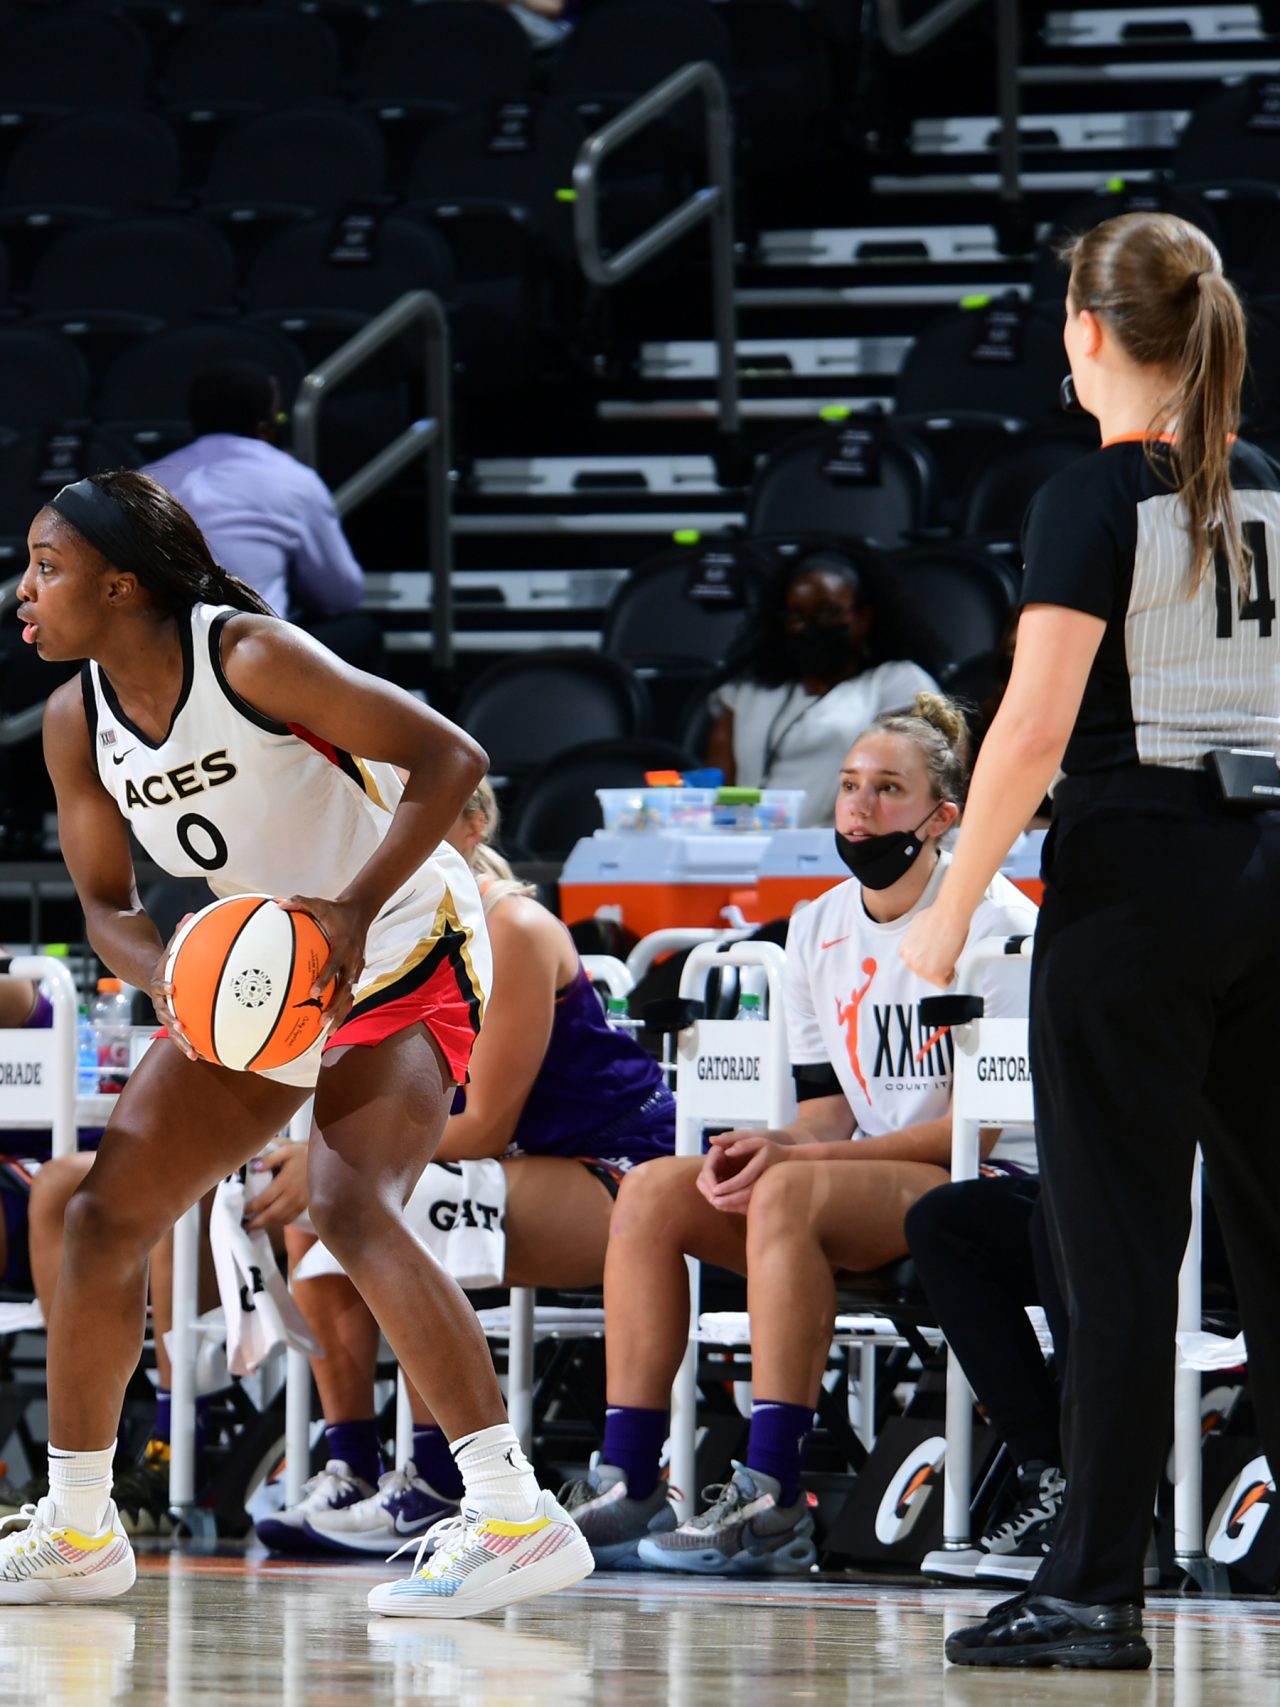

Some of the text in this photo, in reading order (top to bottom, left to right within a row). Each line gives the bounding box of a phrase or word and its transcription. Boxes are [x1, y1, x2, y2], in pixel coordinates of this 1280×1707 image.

[1209, 519, 1277, 638] 14
[125, 749, 239, 810] ACES
[176, 812, 229, 871] 0
[697, 1055, 761, 1081] GATORADE
[885, 1081, 929, 1092] COUNT
